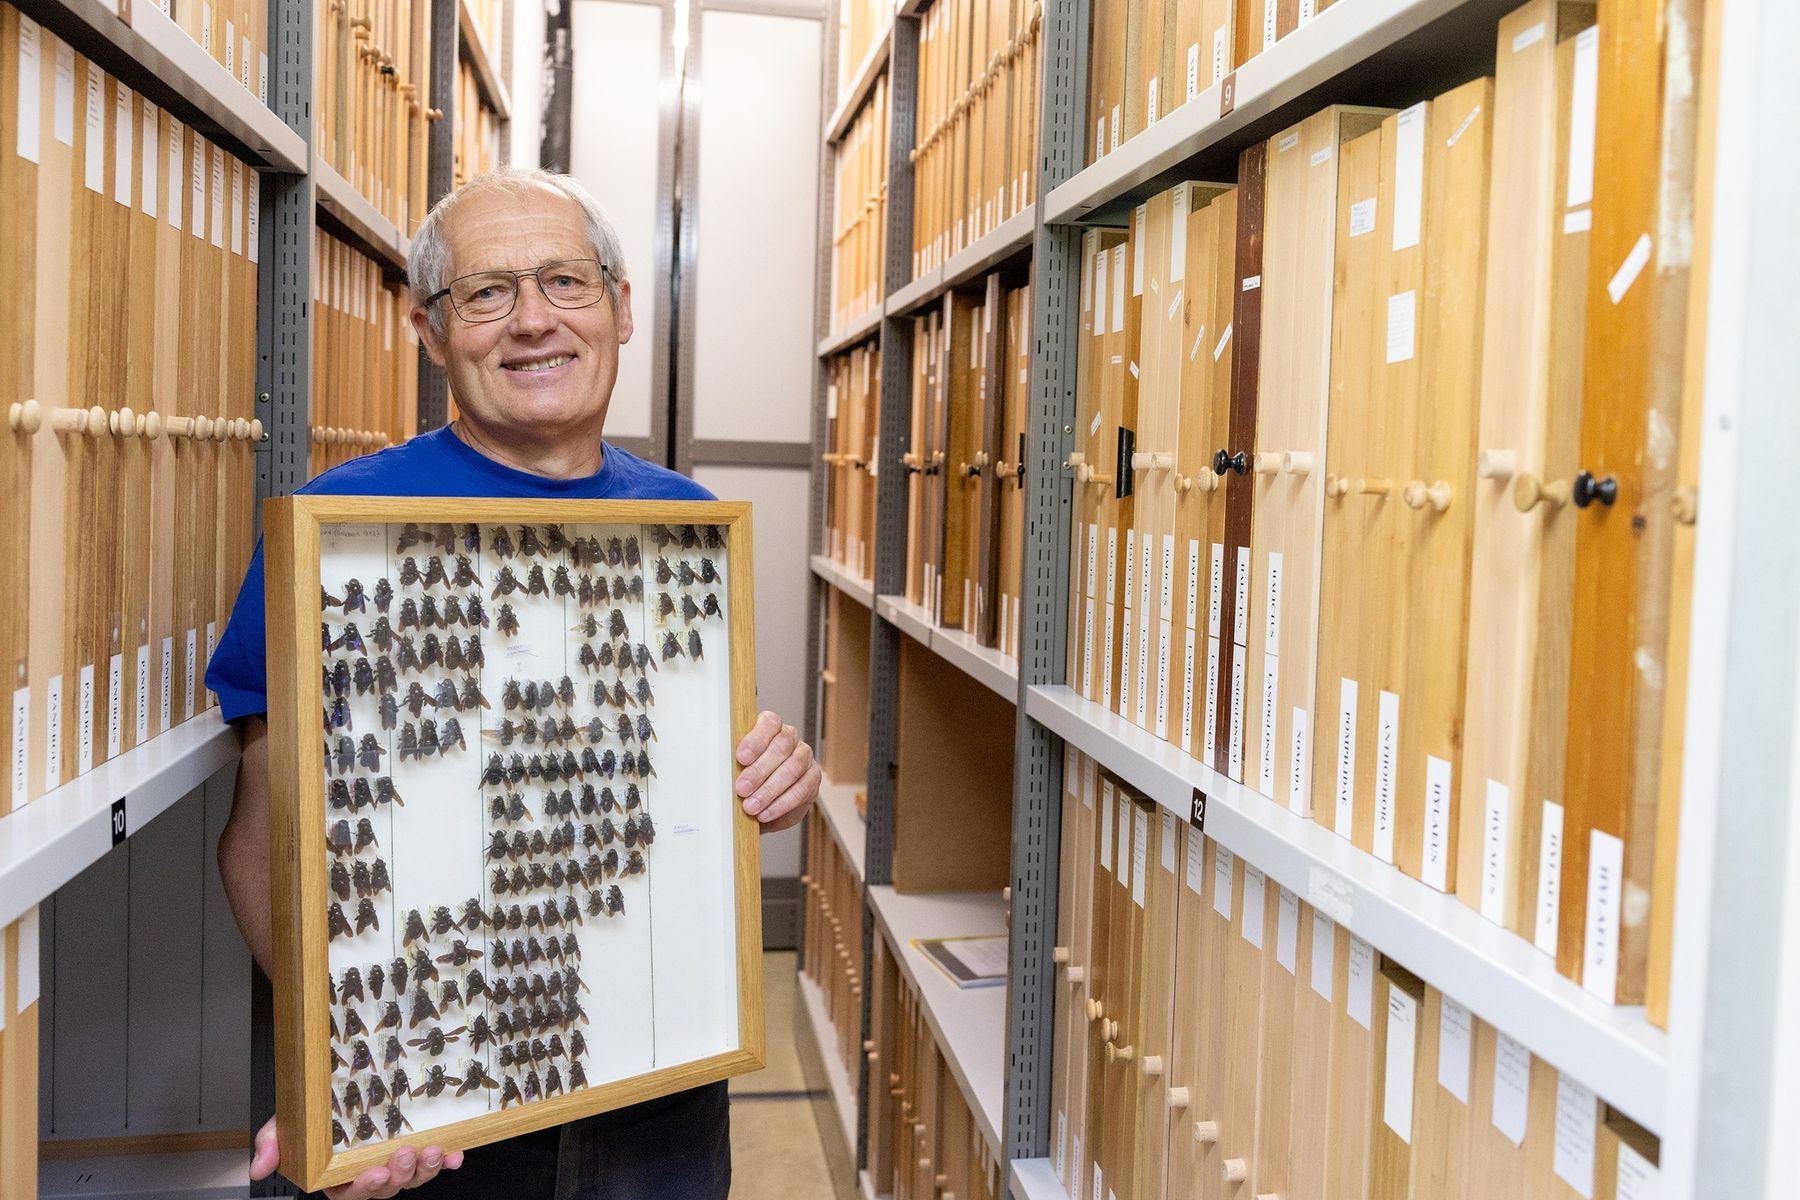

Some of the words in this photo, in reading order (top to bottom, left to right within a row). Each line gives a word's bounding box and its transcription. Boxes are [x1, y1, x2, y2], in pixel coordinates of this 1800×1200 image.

[1225, 84, 1232, 105] 9
[1264, 673, 1272, 778] LASIOGLOSSUM
[1294, 730, 1302, 792] NOMADA
[1341, 711, 1351, 807] POMPILIDAE
[1194, 799, 1203, 821] 12
[1380, 720, 1391, 832] ANTHOPHORA
[113, 809, 124, 835] 10
[1431, 783, 1441, 863] HYLAEUS
[1490, 808, 1499, 896] HYLAEUS
[1546, 833, 1557, 926] HYLAEUS
[1597, 866, 1609, 966] HYLAEUS
